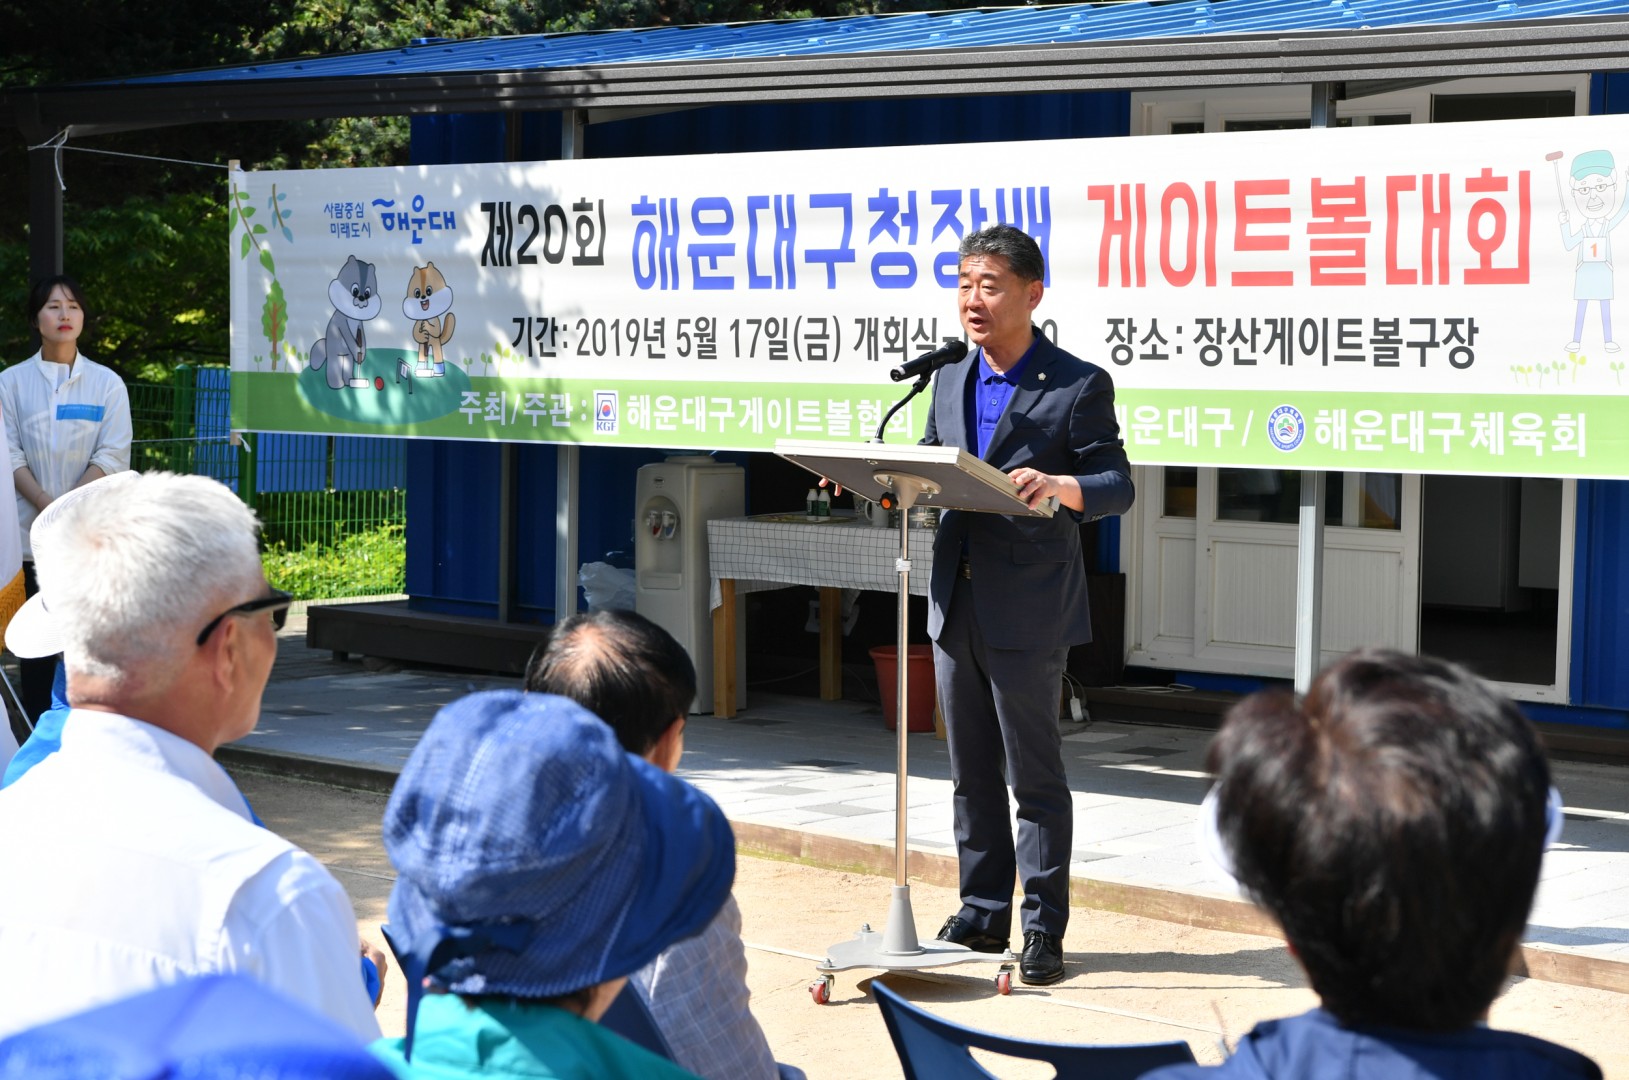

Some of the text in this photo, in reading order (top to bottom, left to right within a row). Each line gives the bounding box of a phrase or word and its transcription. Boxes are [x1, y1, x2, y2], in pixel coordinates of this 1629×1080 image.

[323, 202, 365, 219] 사람중심
[371, 194, 457, 244] 해운대
[481, 197, 606, 267] 제20회
[1087, 167, 1532, 287] 게이트볼대회
[330, 222, 371, 239] 미래도시
[1590, 243, 1598, 258] 1
[576, 317, 666, 360] 2019년
[676, 317, 718, 360] 5월
[729, 315, 841, 362] 17일(금)
[1193, 316, 1480, 369] 장산게이트볼구장
[596, 421, 617, 432] KGF
[626, 394, 914, 438] 해운대구게이트볼협회
[1314, 409, 1587, 457] 해운대구체육회
